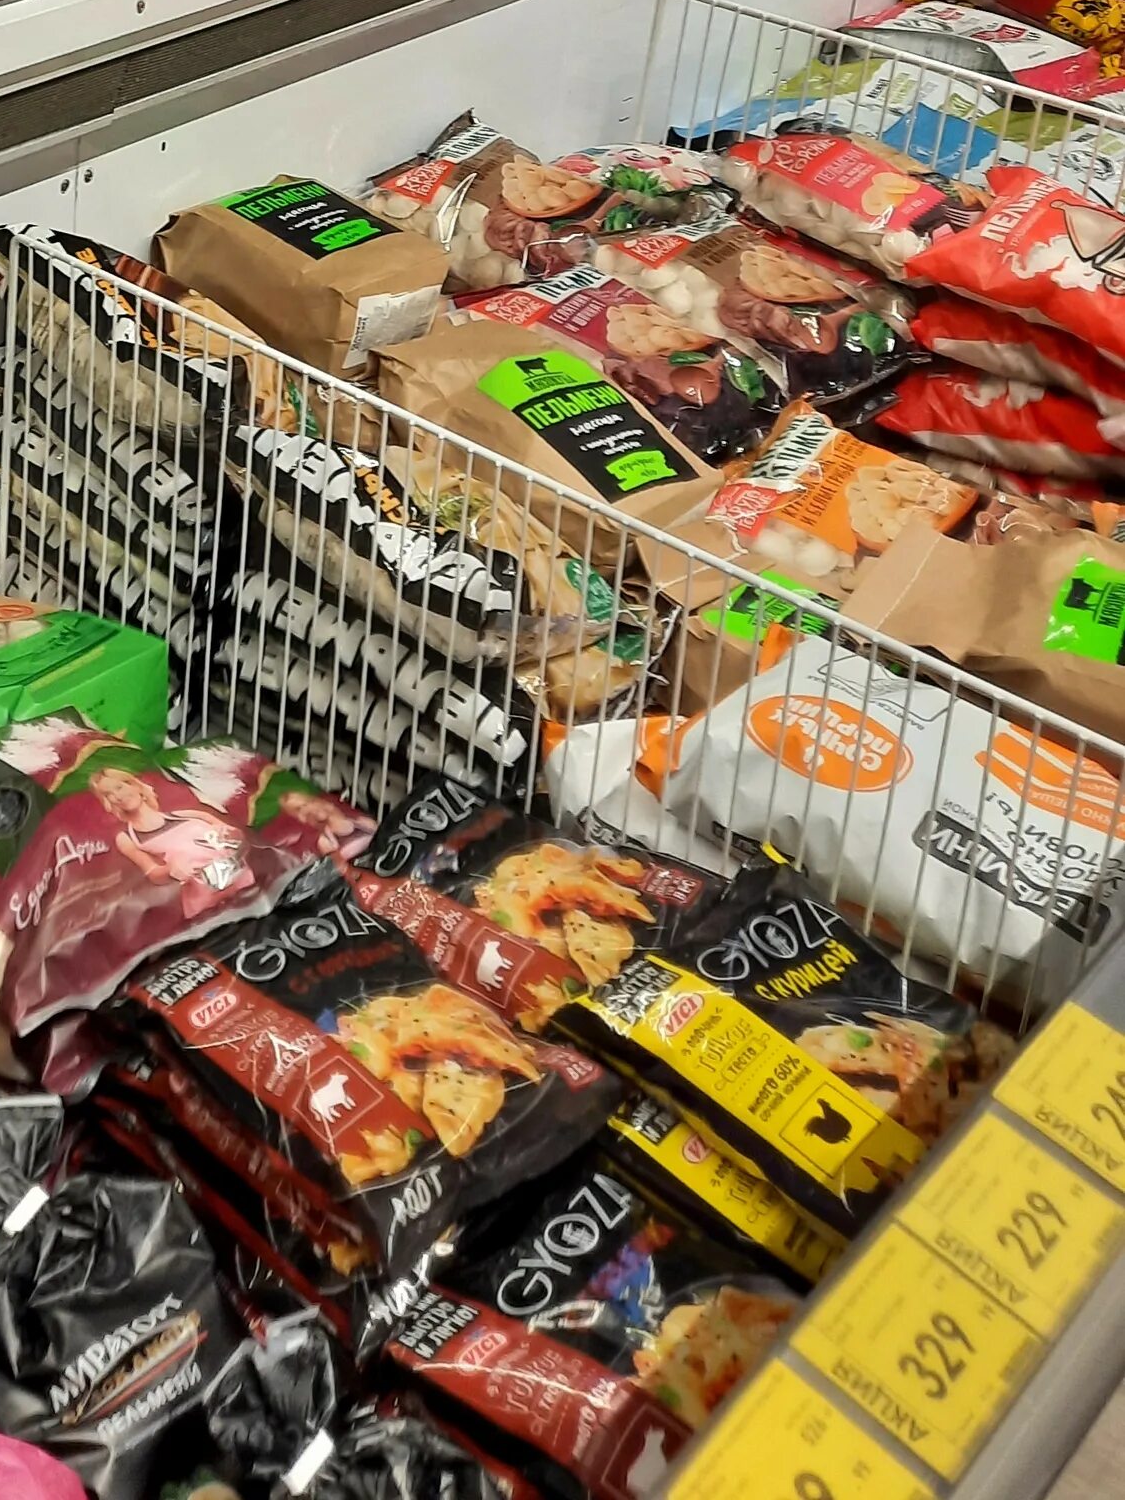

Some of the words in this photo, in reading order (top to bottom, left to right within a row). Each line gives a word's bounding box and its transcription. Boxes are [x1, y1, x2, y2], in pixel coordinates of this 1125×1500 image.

[235, 182, 328, 220] ПЕЛЬМЕНИ
[520, 384, 627, 430] ПЕЛЬМЕНИ
[375, 778, 487, 878] GYOZA
[235, 900, 388, 984] GYOZA
[696, 897, 843, 983] GYOZA
[193, 994, 232, 1025] VICI
[665, 996, 701, 1033] VICI
[1035, 1104, 1125, 1173] АКЦИЯ
[495, 1171, 637, 1318] GYOZA
[934, 1229, 1029, 1306] АКЦИЯ
[996, 1190, 1071, 1273] 229
[463, 1334, 503, 1368] VICI
[898, 1313, 980, 1404] 329
[830, 1356, 932, 1444] АКЦИЯ
